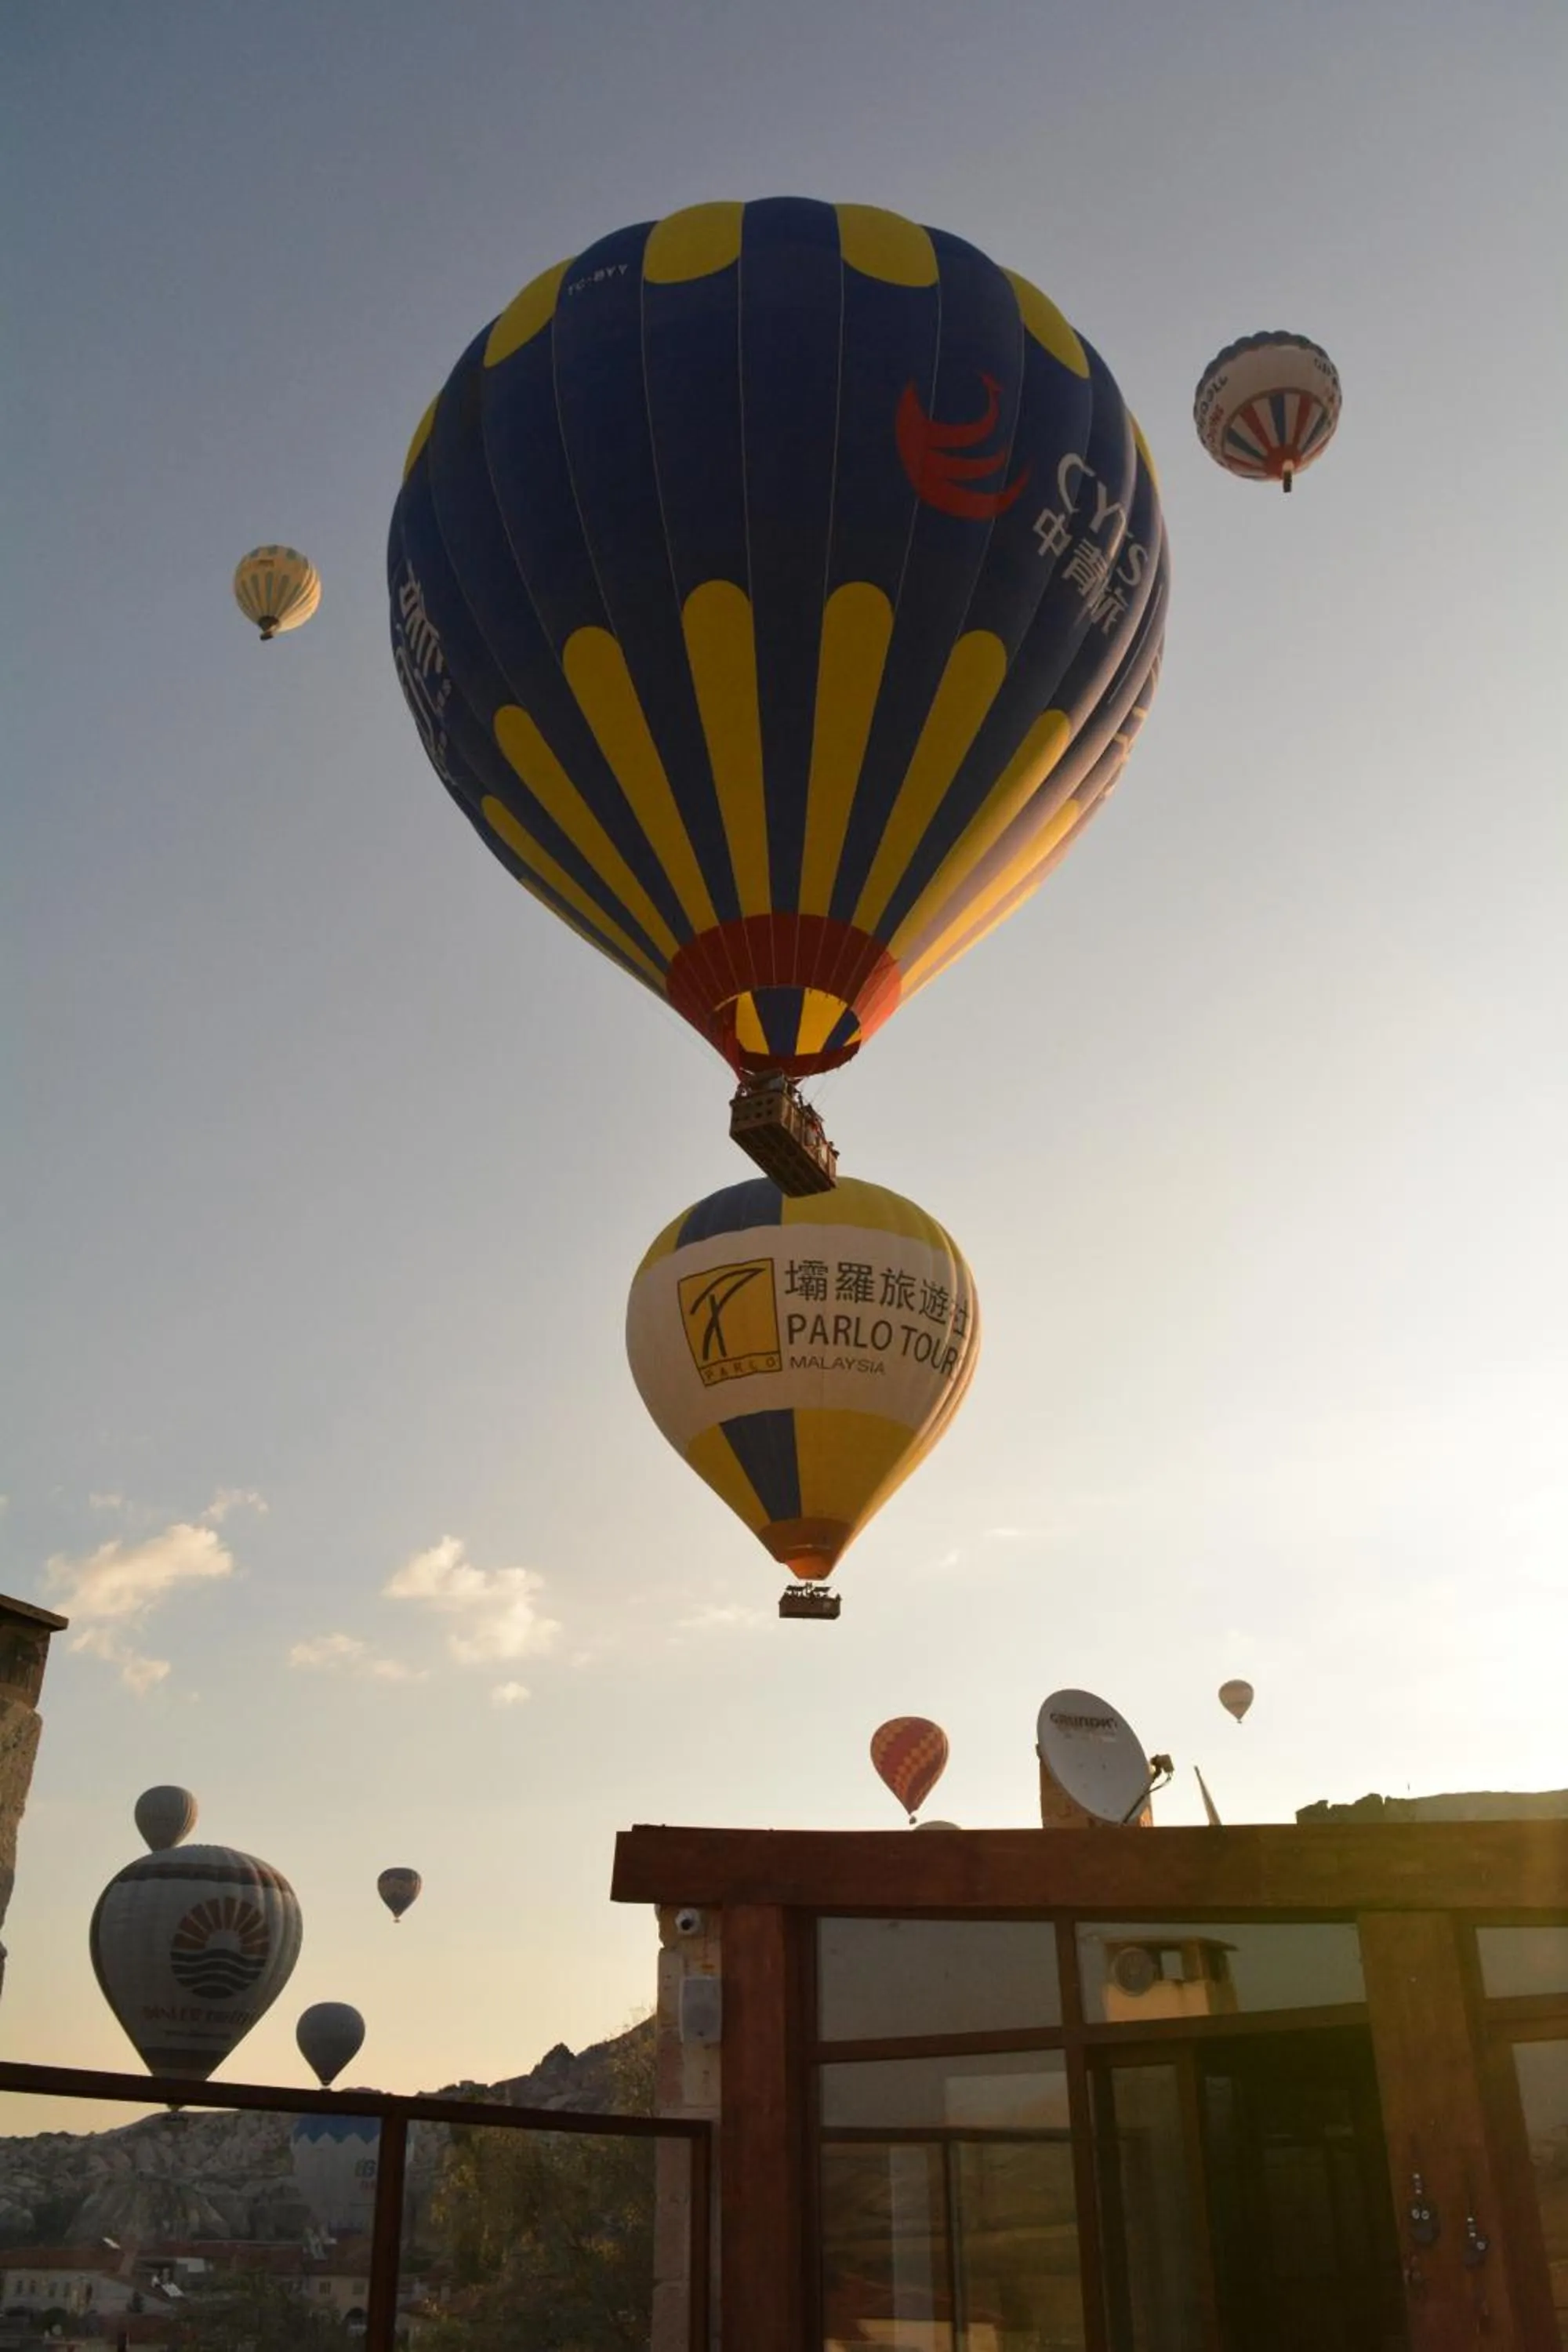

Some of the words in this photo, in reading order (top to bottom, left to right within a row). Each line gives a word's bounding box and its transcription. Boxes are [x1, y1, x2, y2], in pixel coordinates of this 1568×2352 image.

[1058, 452, 1149, 586] CYS
[787, 1313, 894, 1352] PARLO
[901, 1325, 958, 1376] TOUR
[790, 1356, 887, 1375] MALAYSIA
